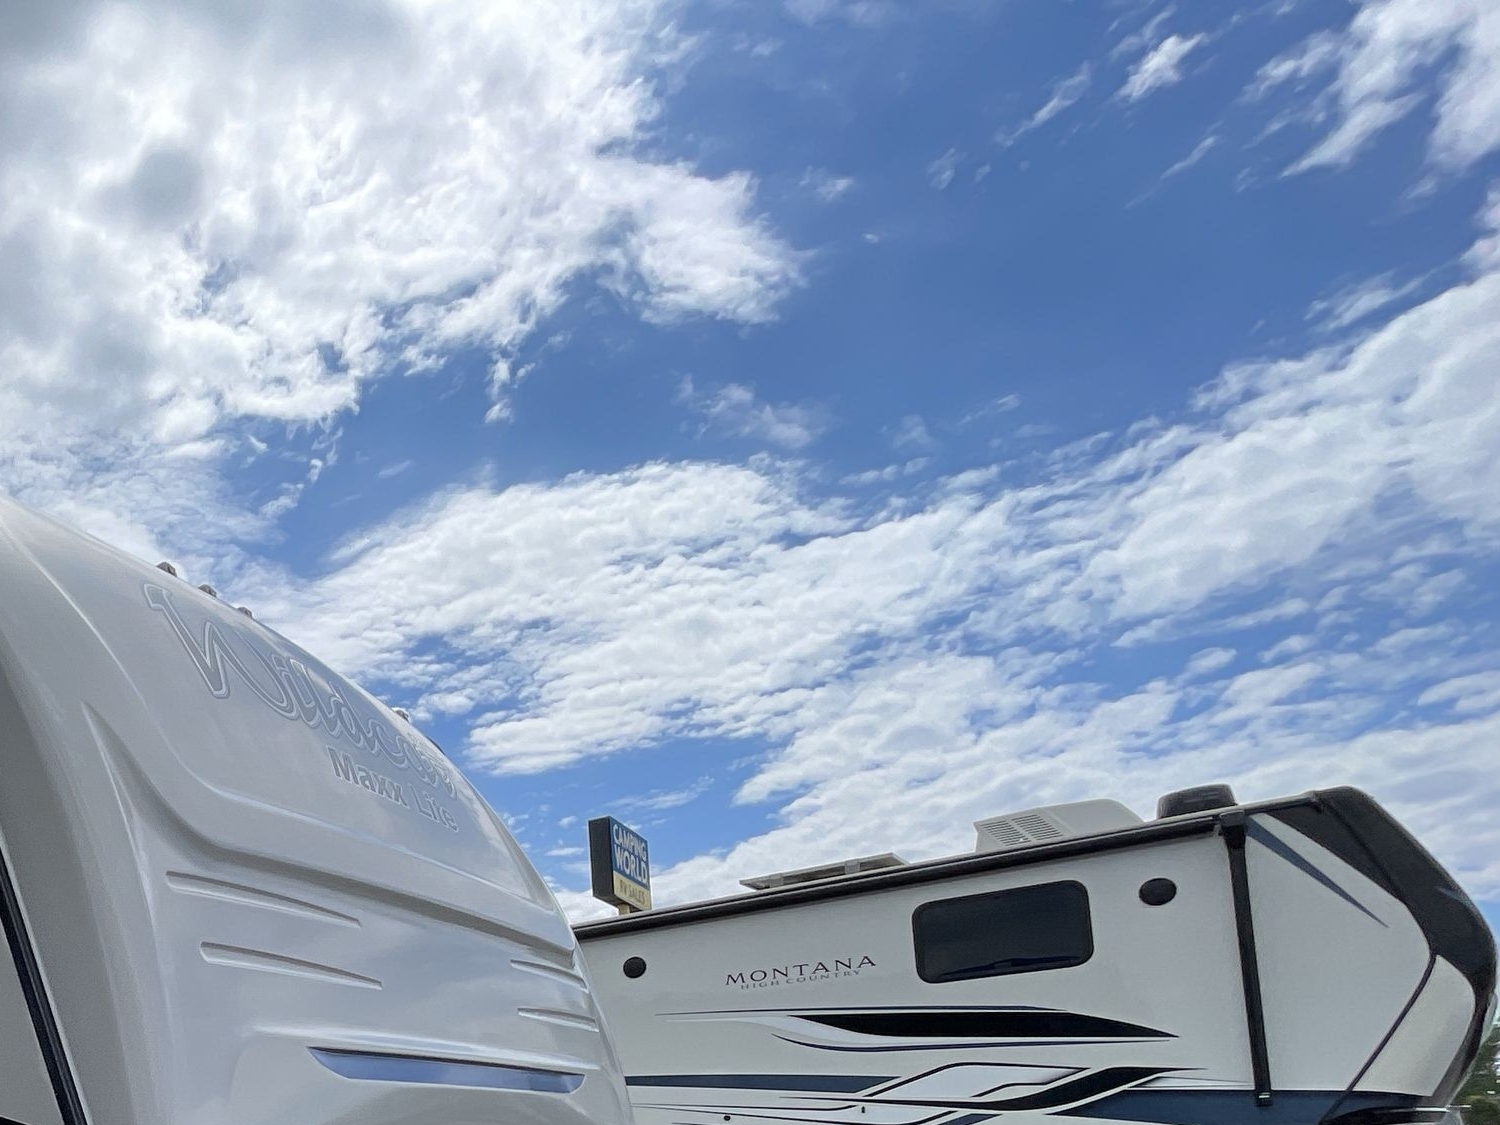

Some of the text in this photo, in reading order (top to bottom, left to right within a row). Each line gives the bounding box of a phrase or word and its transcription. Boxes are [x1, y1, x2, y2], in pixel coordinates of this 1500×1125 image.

[326, 745, 409, 809] Maxx
[612, 823, 647, 862] CAMPING
[614, 843, 648, 884] WORLD
[725, 955, 876, 986] MONTANA
[741, 969, 861, 990] HIGH COUNTRY
